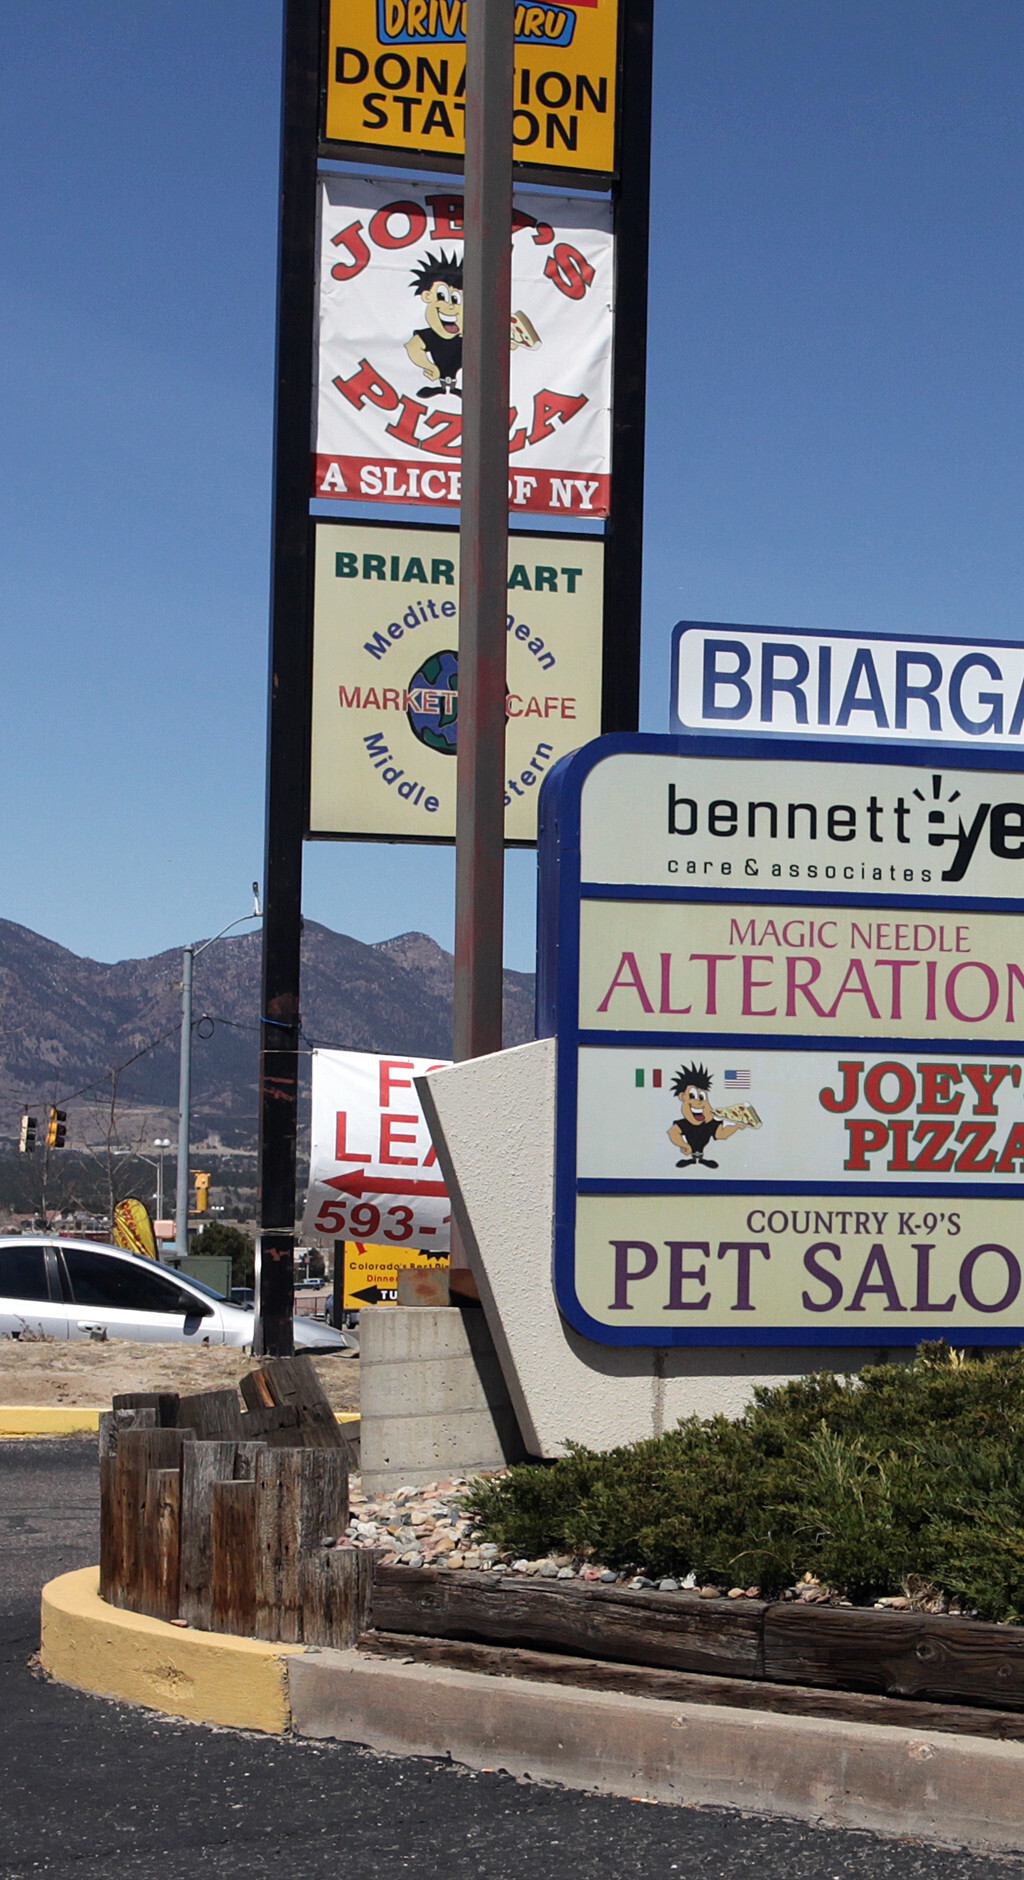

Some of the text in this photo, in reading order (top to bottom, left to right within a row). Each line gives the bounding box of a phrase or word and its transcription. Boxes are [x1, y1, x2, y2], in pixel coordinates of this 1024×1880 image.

[384, 0, 466, 38] DRIV
[335, 47, 608, 113] DONION
[362, 92, 578, 151] STAON
[320, 463, 348, 492] A
[549, 478, 599, 509] NY
[335, 552, 582, 594] BRIAR ART
[363, 599, 557, 671] Meditenean
[339, 685, 577, 720] MARKET CAFE
[363, 732, 440, 813] Middle
[667, 783, 911, 844] bennett
[667, 858, 932, 882] care & associates
[729, 918, 972, 953] MAGIC NEEDLE
[746, 1210, 962, 1236] COUNTRY K-9'S
[607, 1240, 771, 1312] PET
